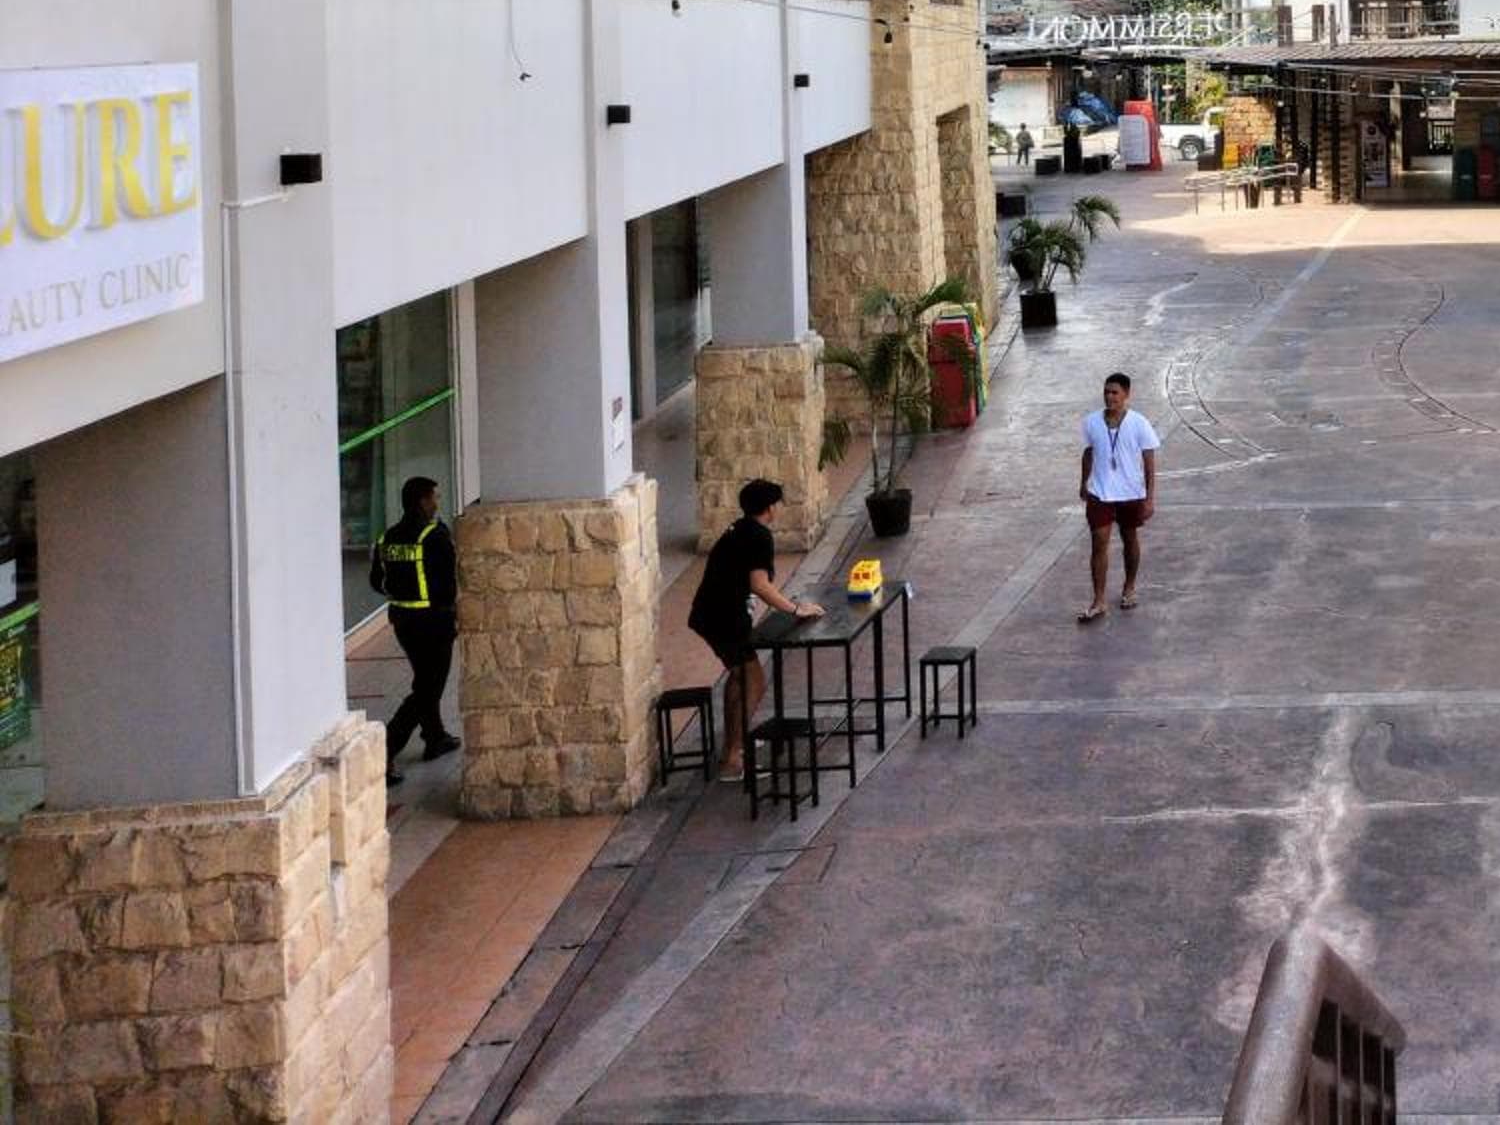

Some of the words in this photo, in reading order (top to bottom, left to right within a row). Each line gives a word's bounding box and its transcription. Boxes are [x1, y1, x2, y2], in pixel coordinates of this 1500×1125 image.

[0, 91, 198, 246] URE
[0, 279, 87, 338] AUTY
[99, 253, 191, 310] CLINIC
